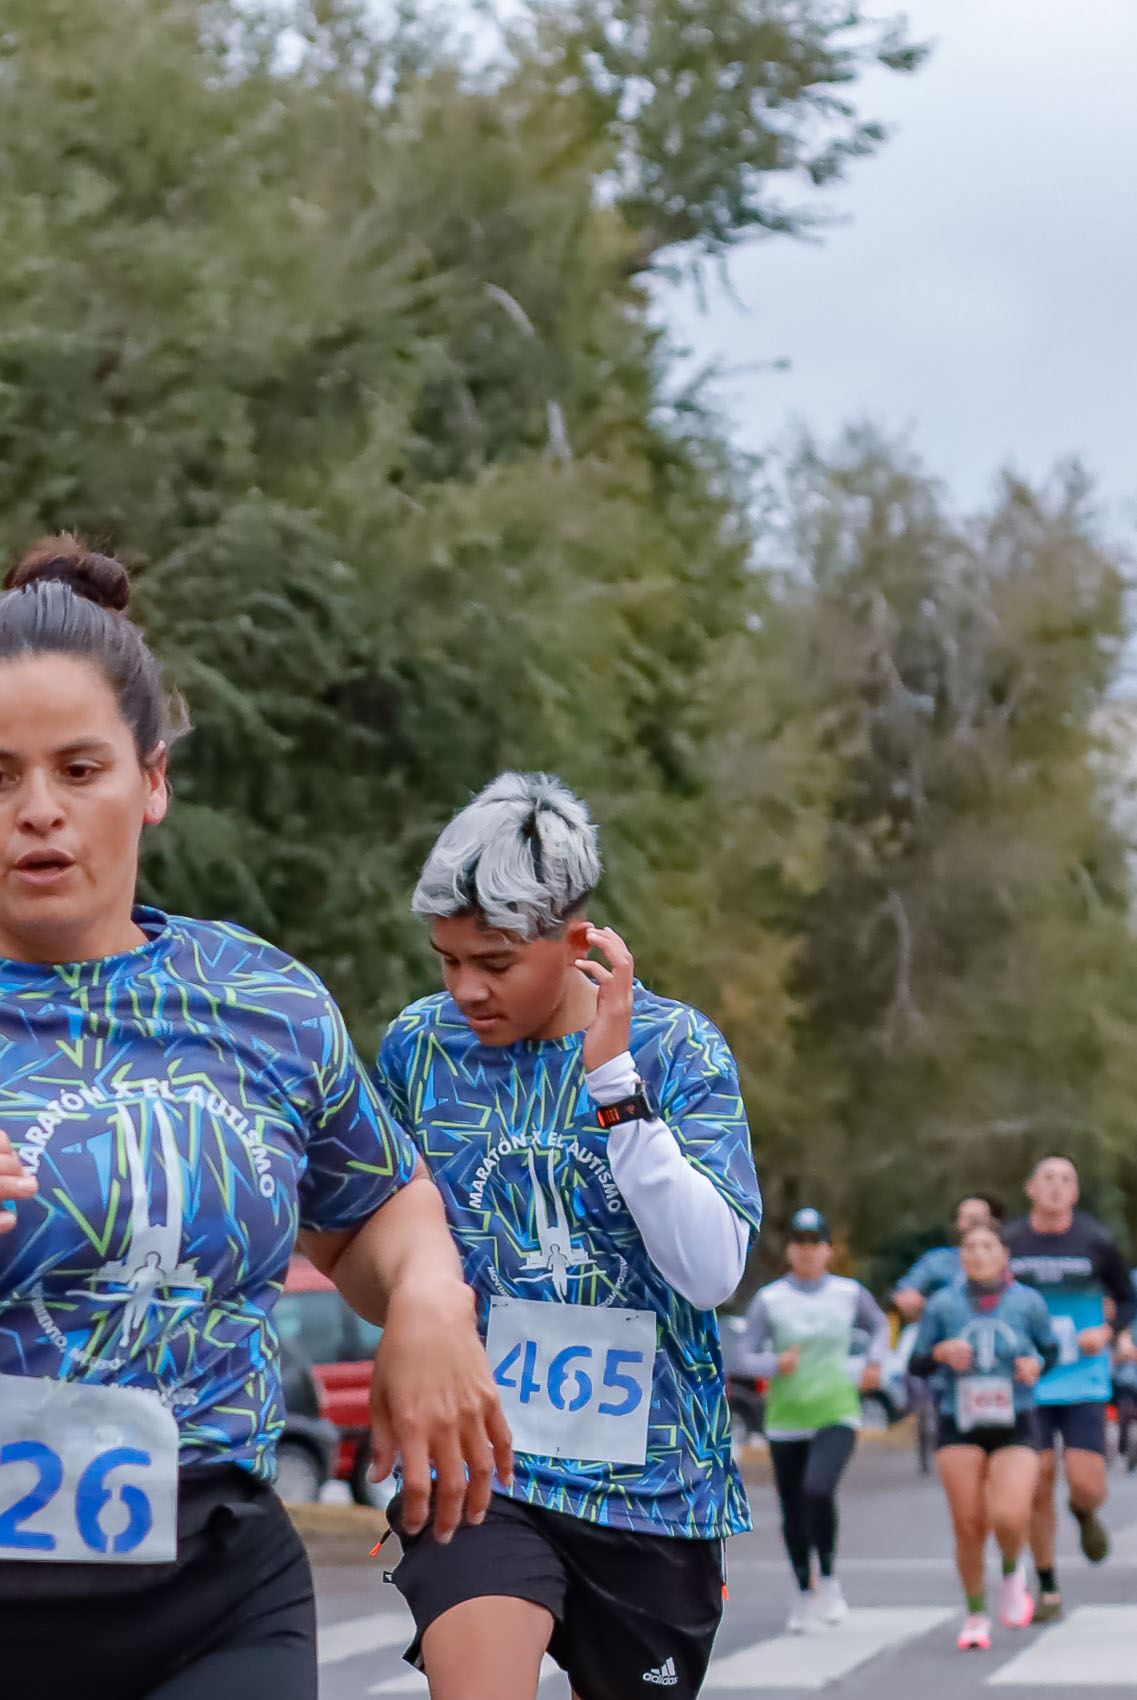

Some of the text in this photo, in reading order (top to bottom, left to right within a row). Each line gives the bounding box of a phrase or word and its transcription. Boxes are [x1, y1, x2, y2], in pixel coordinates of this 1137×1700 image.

[110, 1080, 136, 1098] X
[142, 1079, 177, 1101] EL
[468, 1129, 622, 1213] MARATÓN X EL AUTISMO
[493, 1340, 644, 1417] 465
